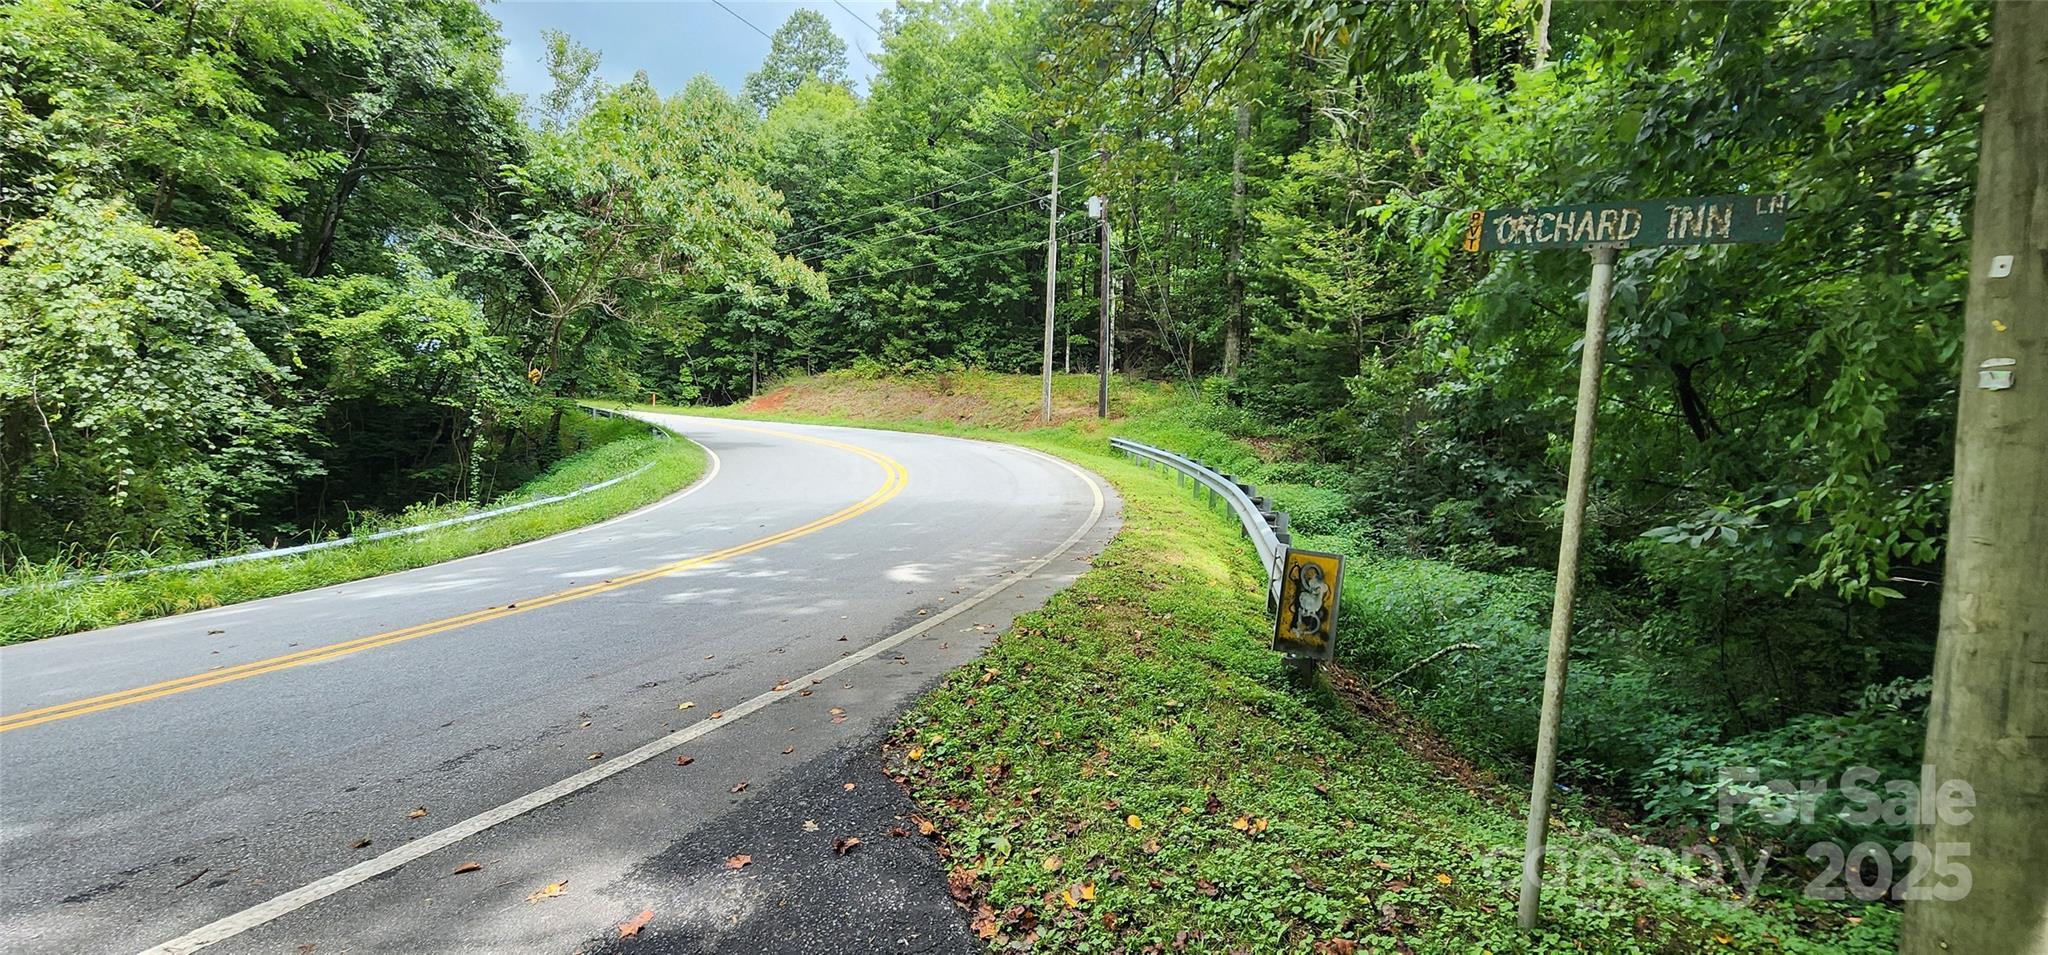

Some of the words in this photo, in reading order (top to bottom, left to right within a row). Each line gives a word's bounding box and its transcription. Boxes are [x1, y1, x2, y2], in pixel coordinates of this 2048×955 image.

[1466, 212, 1481, 250] PVT
[1493, 206, 1642, 245] ORCHARD
[1665, 202, 1735, 240] INN
[1755, 195, 1786, 216] LN
